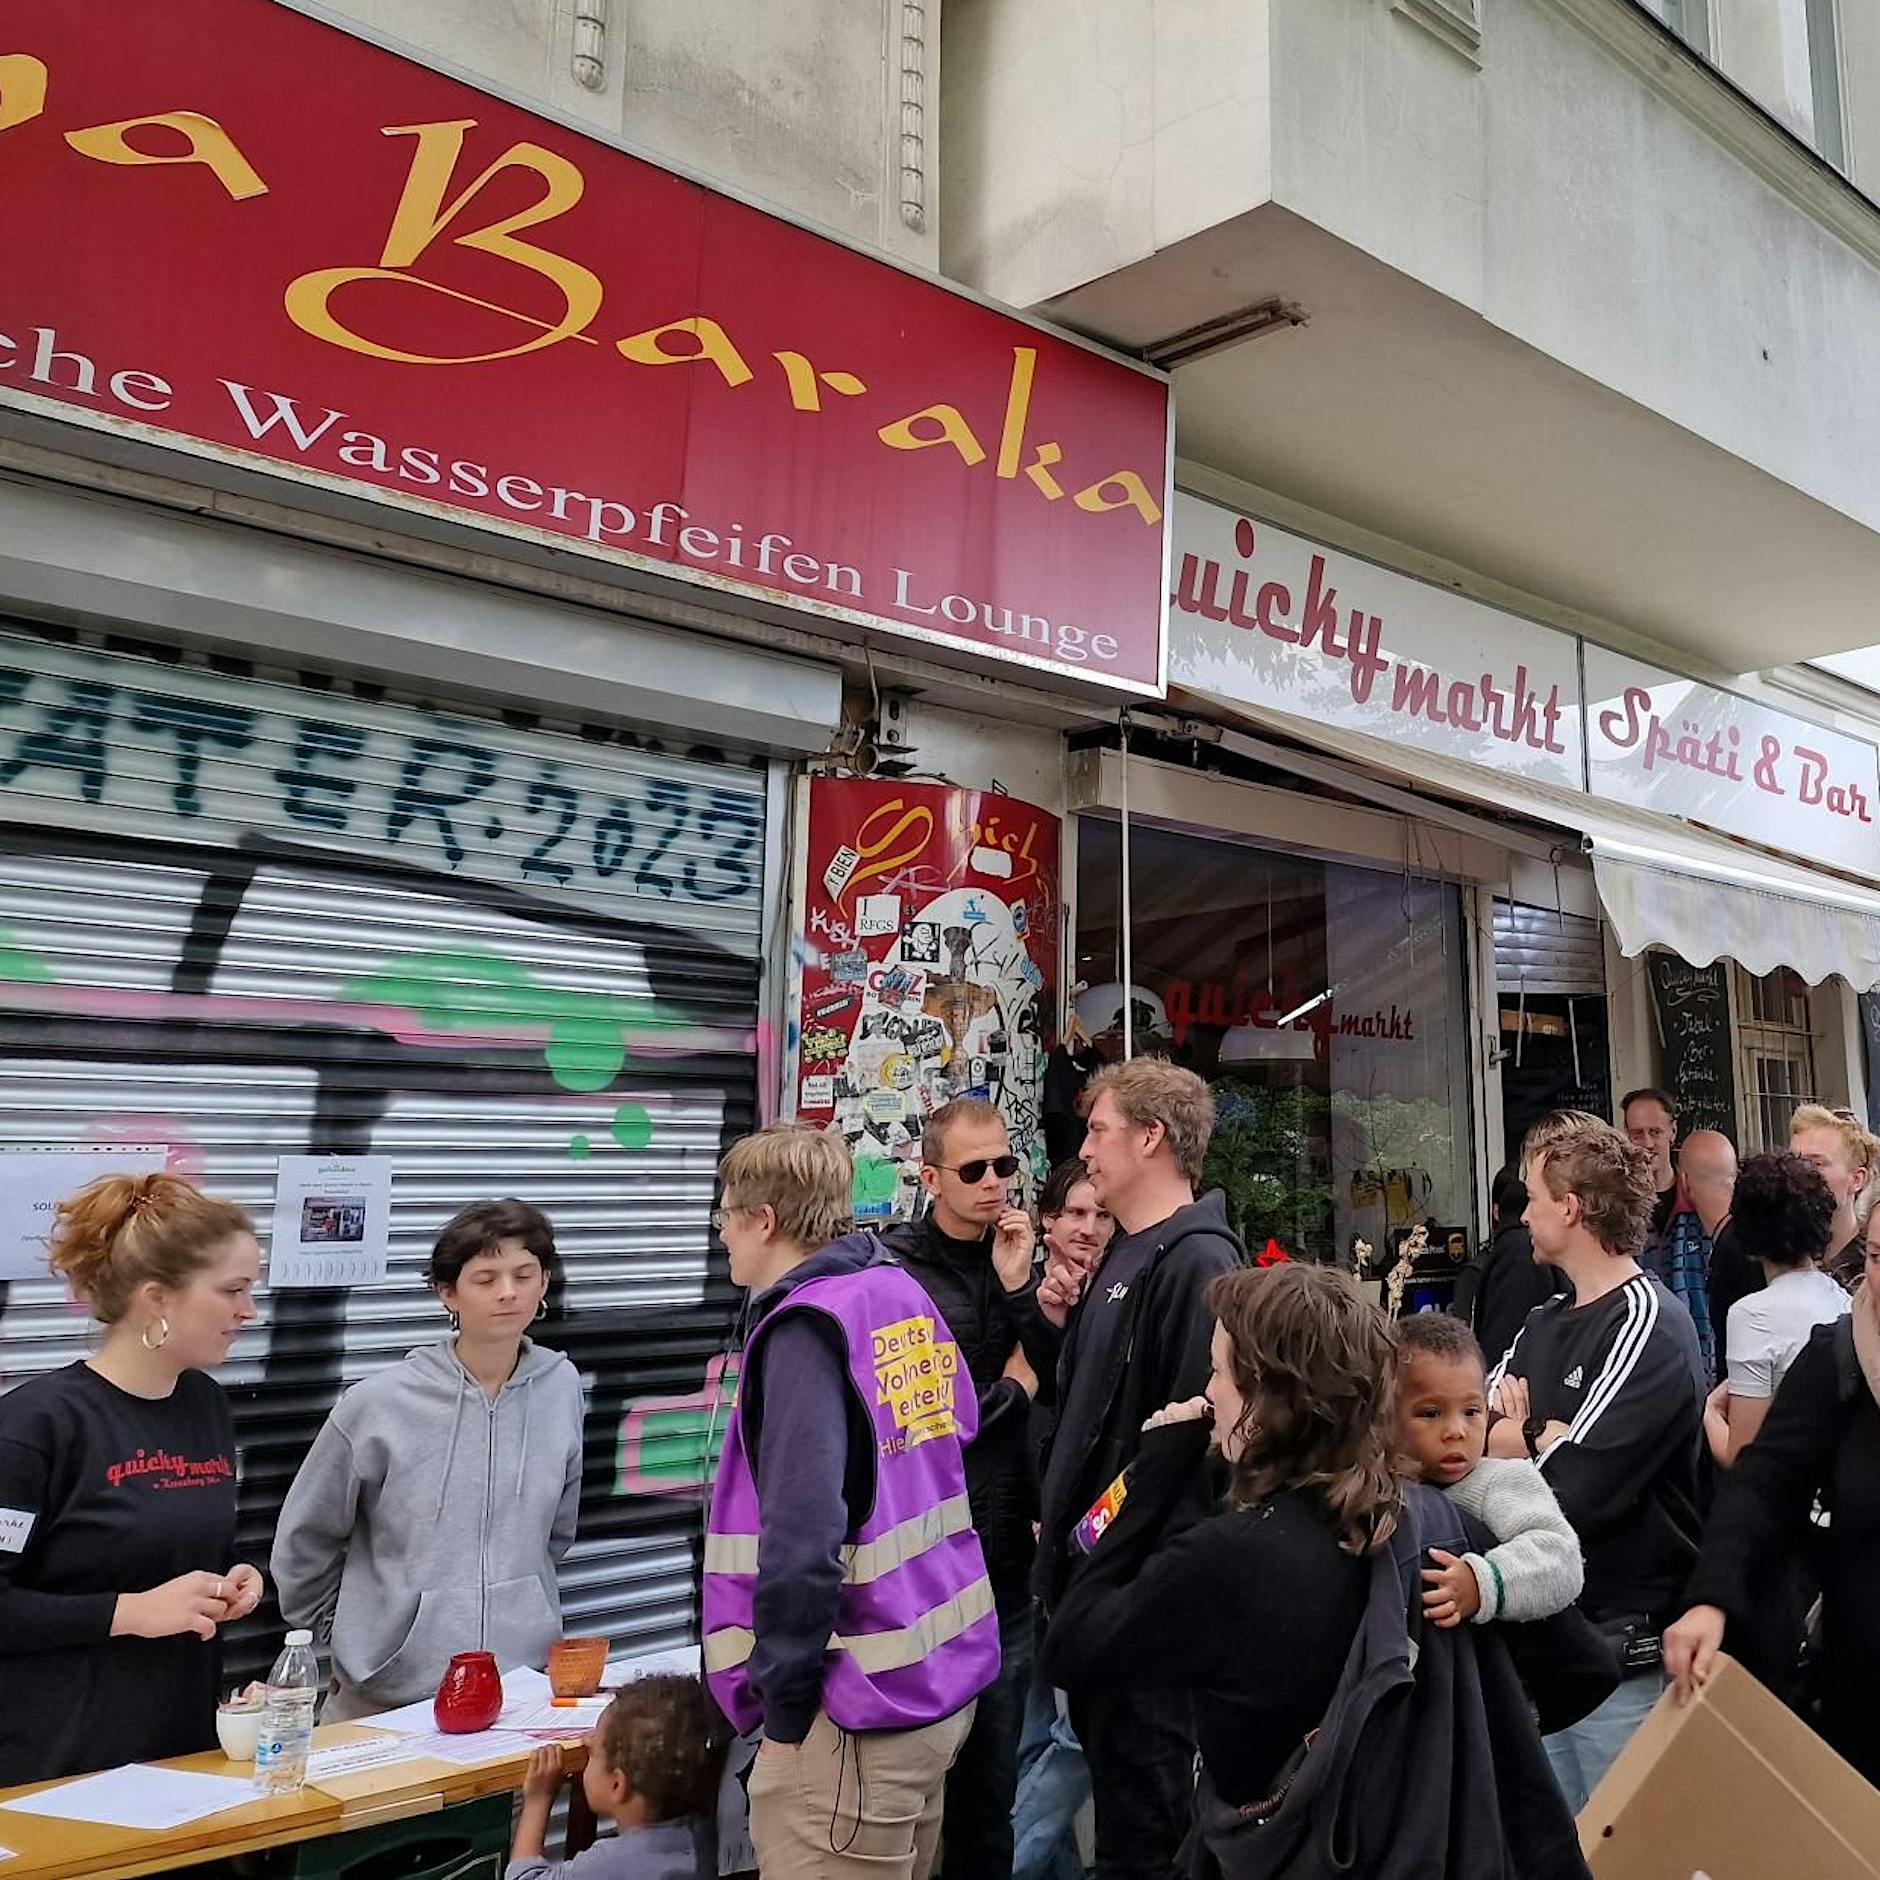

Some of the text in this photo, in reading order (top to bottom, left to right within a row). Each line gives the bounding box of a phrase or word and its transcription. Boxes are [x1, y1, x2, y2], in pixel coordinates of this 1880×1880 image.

[283, 118, 1162, 526] Baraka
[215, 377, 865, 600] Wasserpfeifen
[889, 568, 1120, 663] Lounge
[1169, 517, 1566, 755] uicky markt
[1599, 686, 1873, 824] Späti & Bar
[1340, 1004, 1414, 1041] markt
